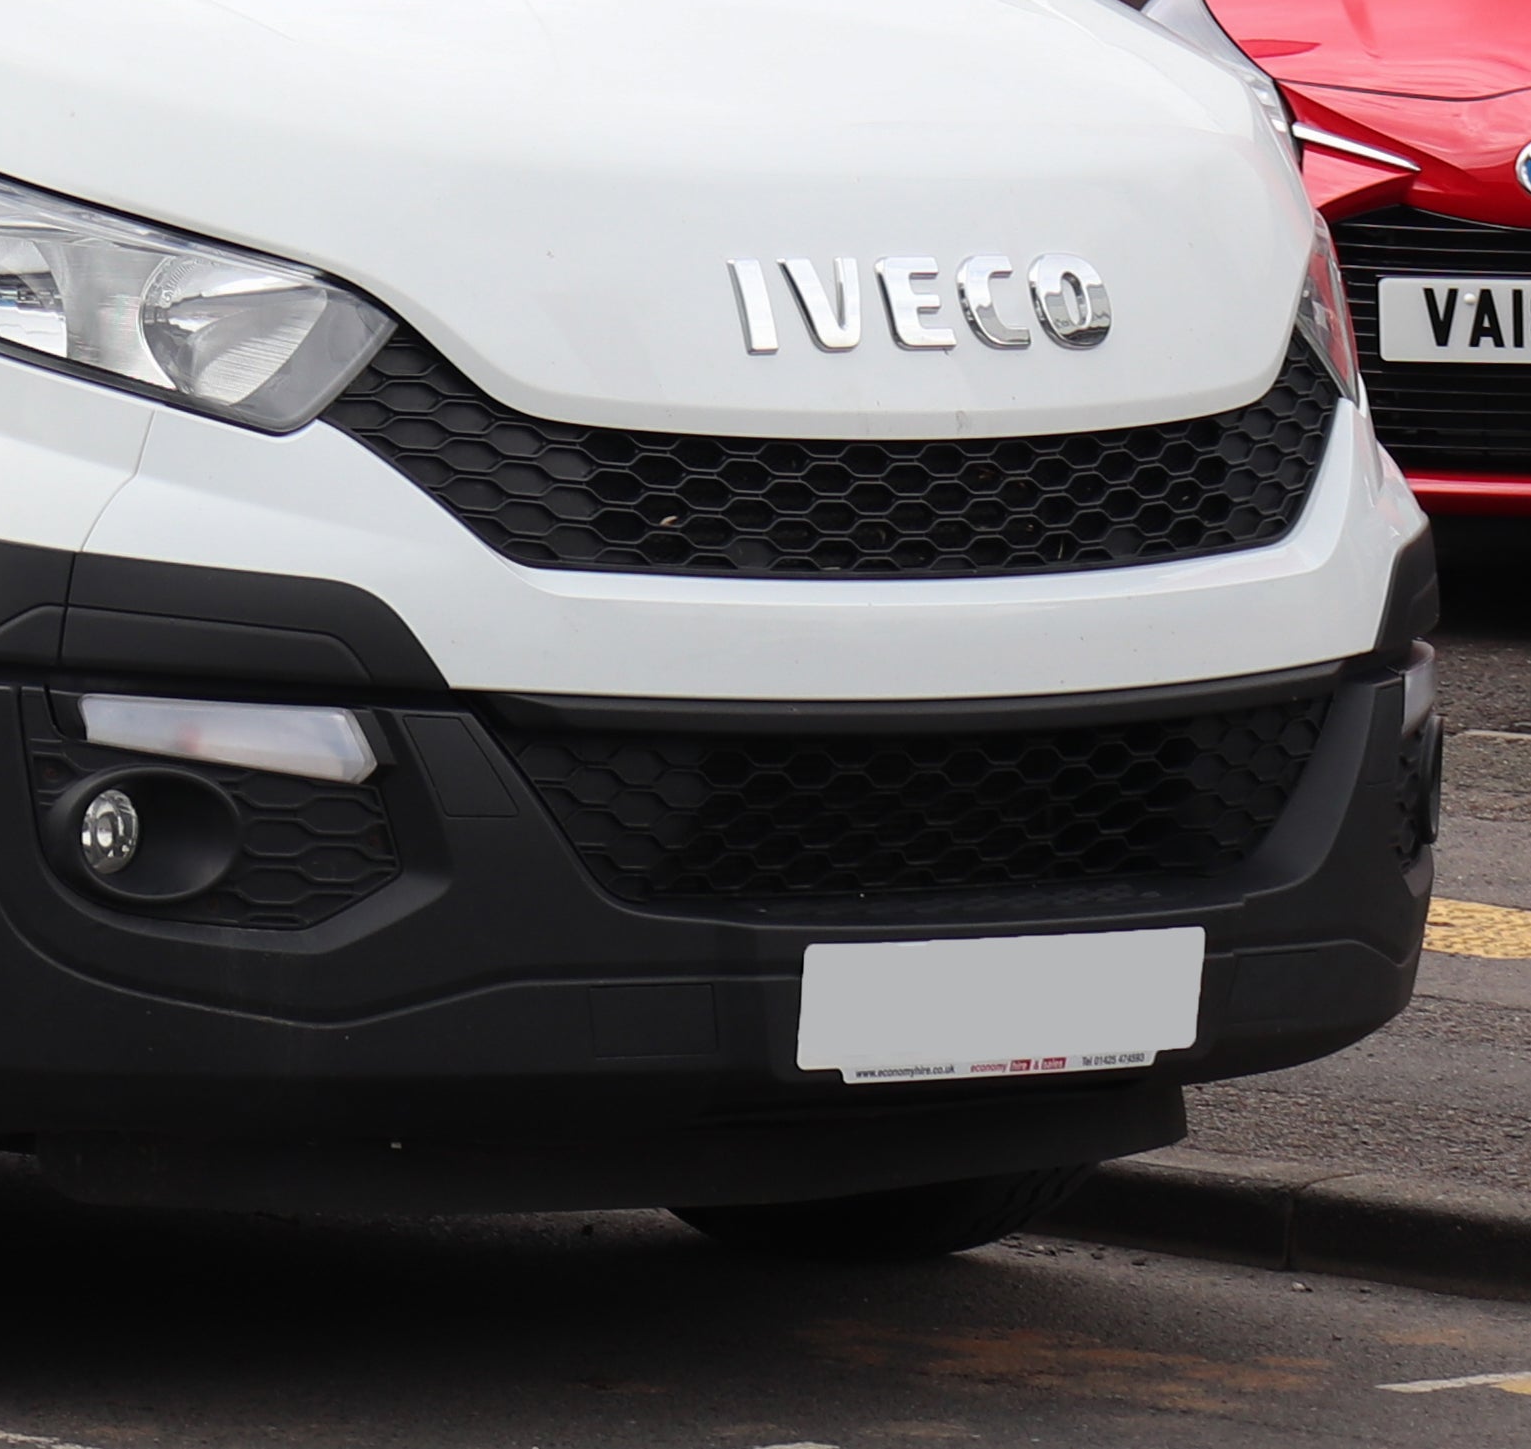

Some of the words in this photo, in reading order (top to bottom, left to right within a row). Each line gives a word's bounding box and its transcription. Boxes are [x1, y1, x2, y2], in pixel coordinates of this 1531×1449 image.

[726, 253, 1113, 356] IVECO
[855, 1063, 956, 1078] www.economyhire.co.uk
[970, 1062, 1007, 1073] economy
